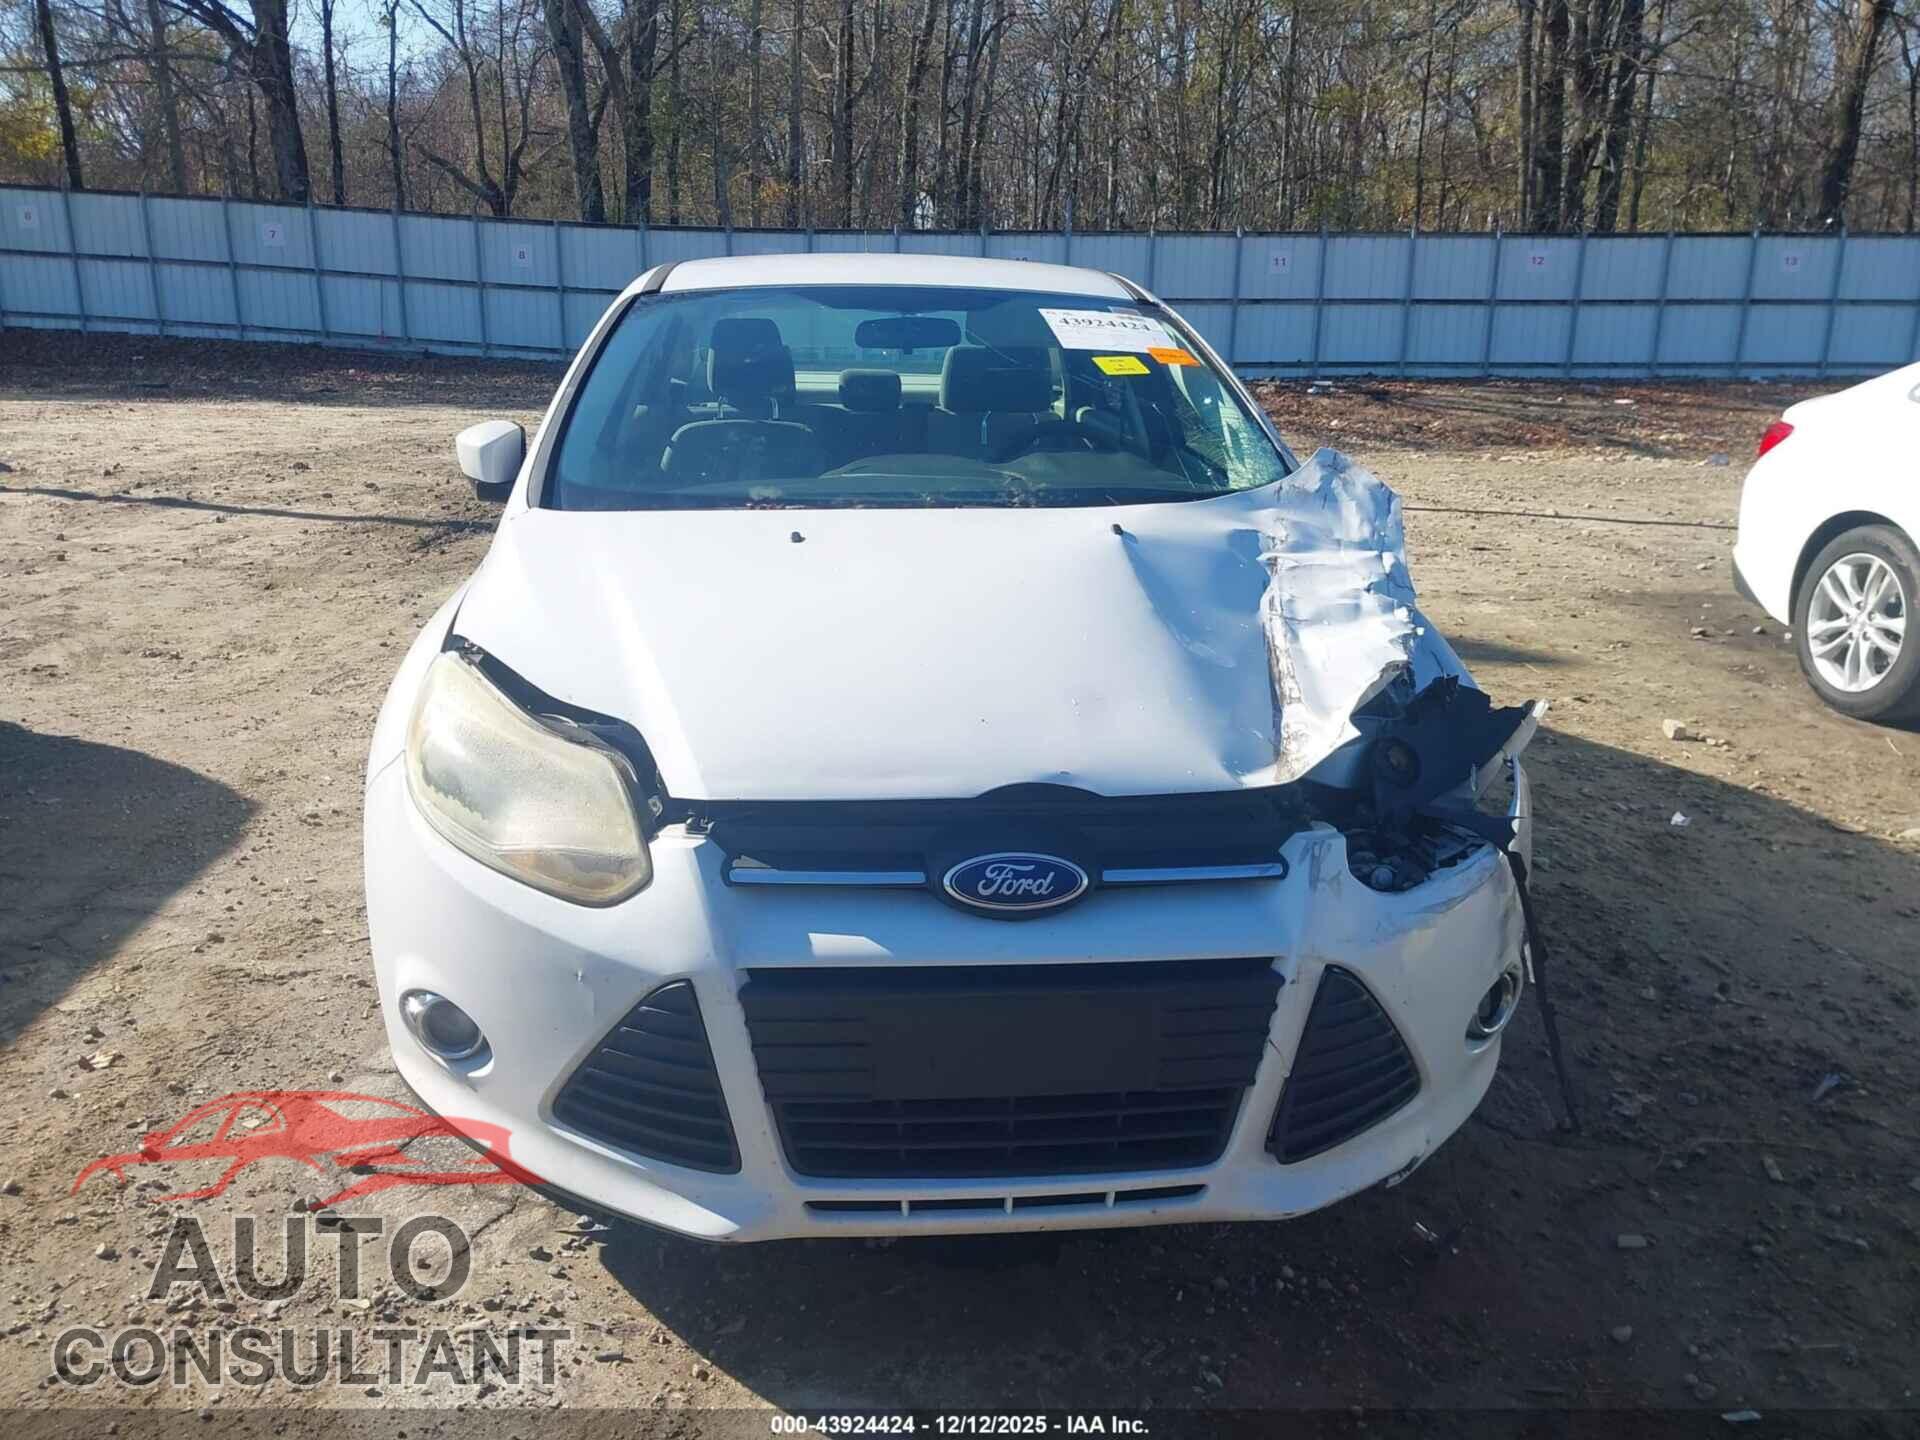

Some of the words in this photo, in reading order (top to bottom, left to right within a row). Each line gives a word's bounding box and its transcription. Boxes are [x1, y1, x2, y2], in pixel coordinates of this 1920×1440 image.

[268, 229, 276, 239] 7
[518, 250, 526, 260] 8
[1274, 257, 1286, 266] 11
[1531, 256, 1545, 265] 12
[1059, 317, 1152, 332] 43924424
[976, 863, 1056, 897] Ford
